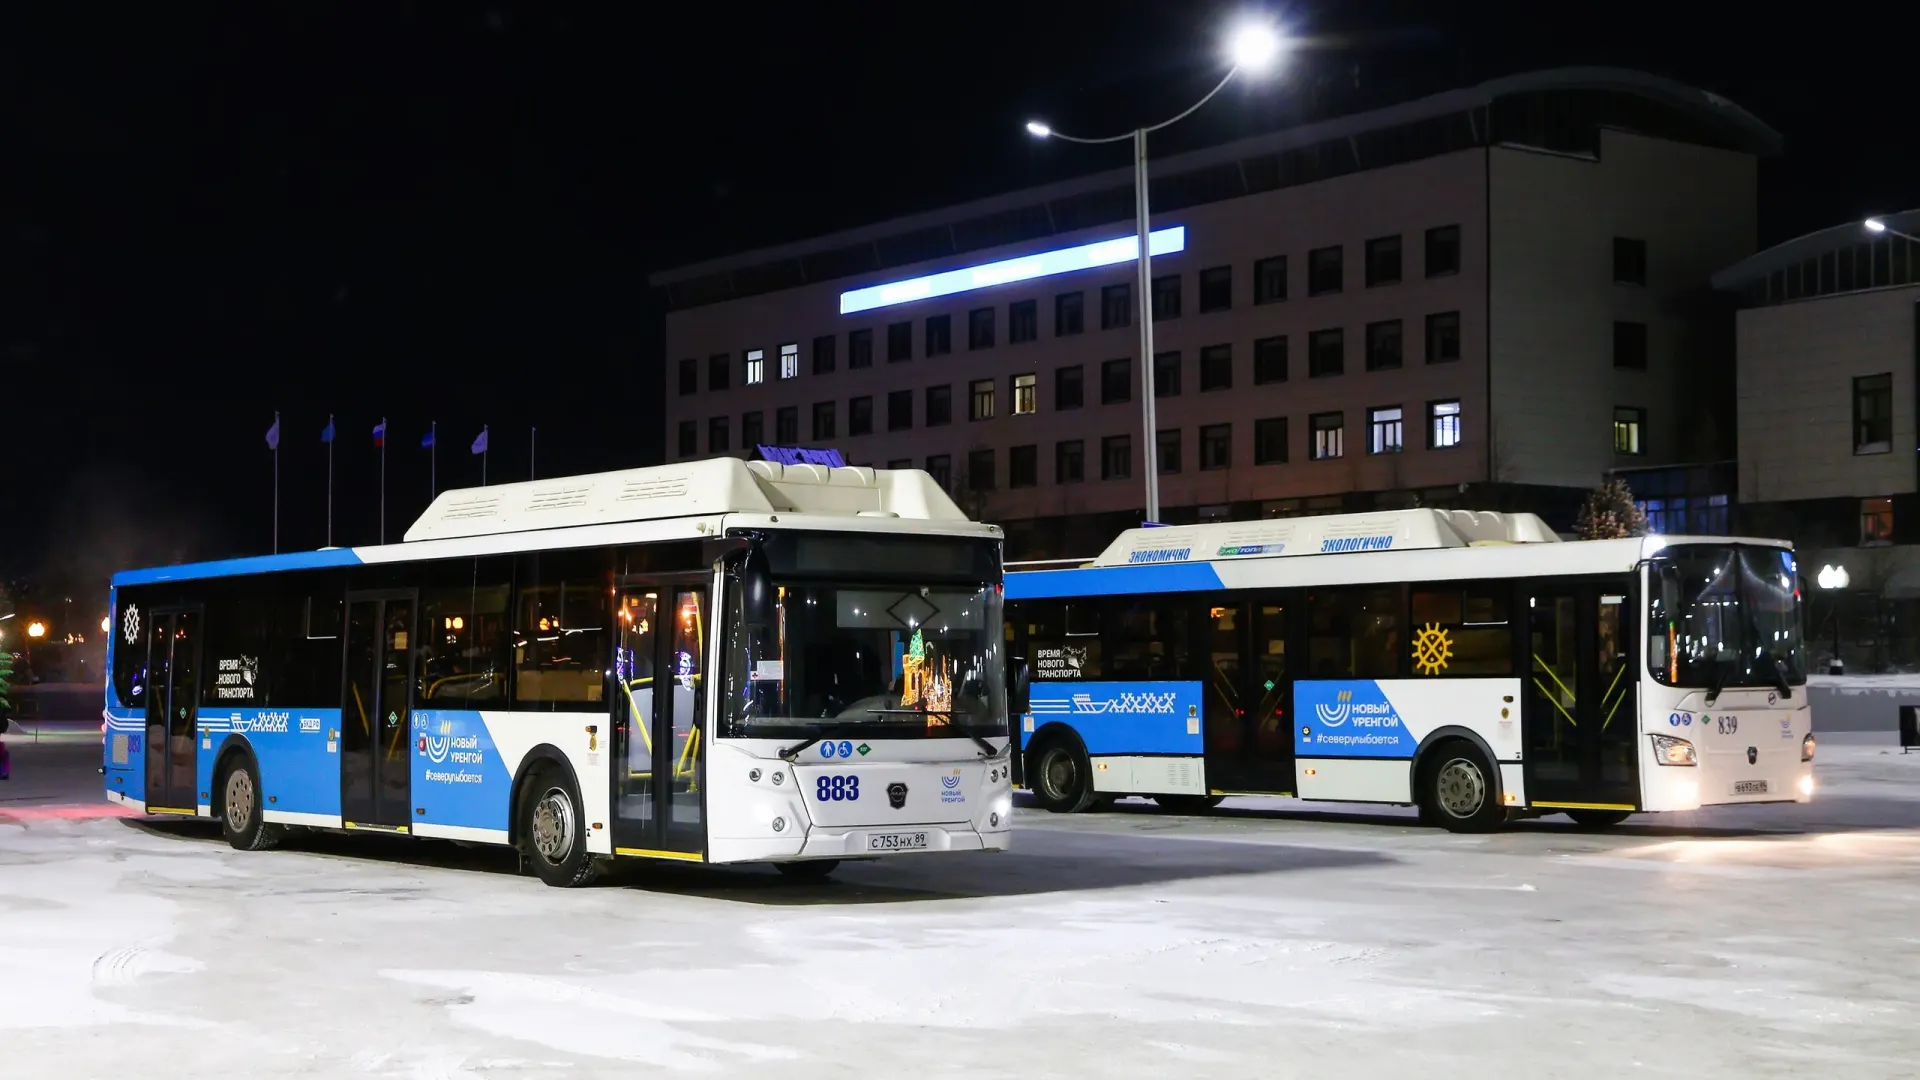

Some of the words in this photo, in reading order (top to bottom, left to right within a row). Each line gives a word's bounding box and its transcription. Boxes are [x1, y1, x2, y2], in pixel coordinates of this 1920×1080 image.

[1321, 535, 1393, 552] ЭКОЛОГИЧНО
[1128, 548, 1191, 563] ЭКОНОМИЧНО
[1037, 649, 1061, 658] ВРЕМЯ
[219, 659, 239, 671] ВРЕМЯ
[1037, 659, 1065, 668] НОВОГО
[218, 673, 241, 685] НОВОГО
[1037, 669, 1082, 678] ТРАНСПОРТА
[218, 687, 254, 699] ТРАНСПОРТА
[1352, 701, 1390, 714] НОВЫЙ
[1352, 715, 1399, 728] УРЕНГОЙ
[1718, 715, 1738, 735] 839
[450, 734, 478, 749] НОВЫЙ
[1316, 733, 1399, 747] #северулыбается
[450, 750, 483, 764] УРЕНГОЙ
[425, 768, 482, 785] #северулыбается
[816, 775, 860, 802] 883
[914, 833, 925, 844] 89
